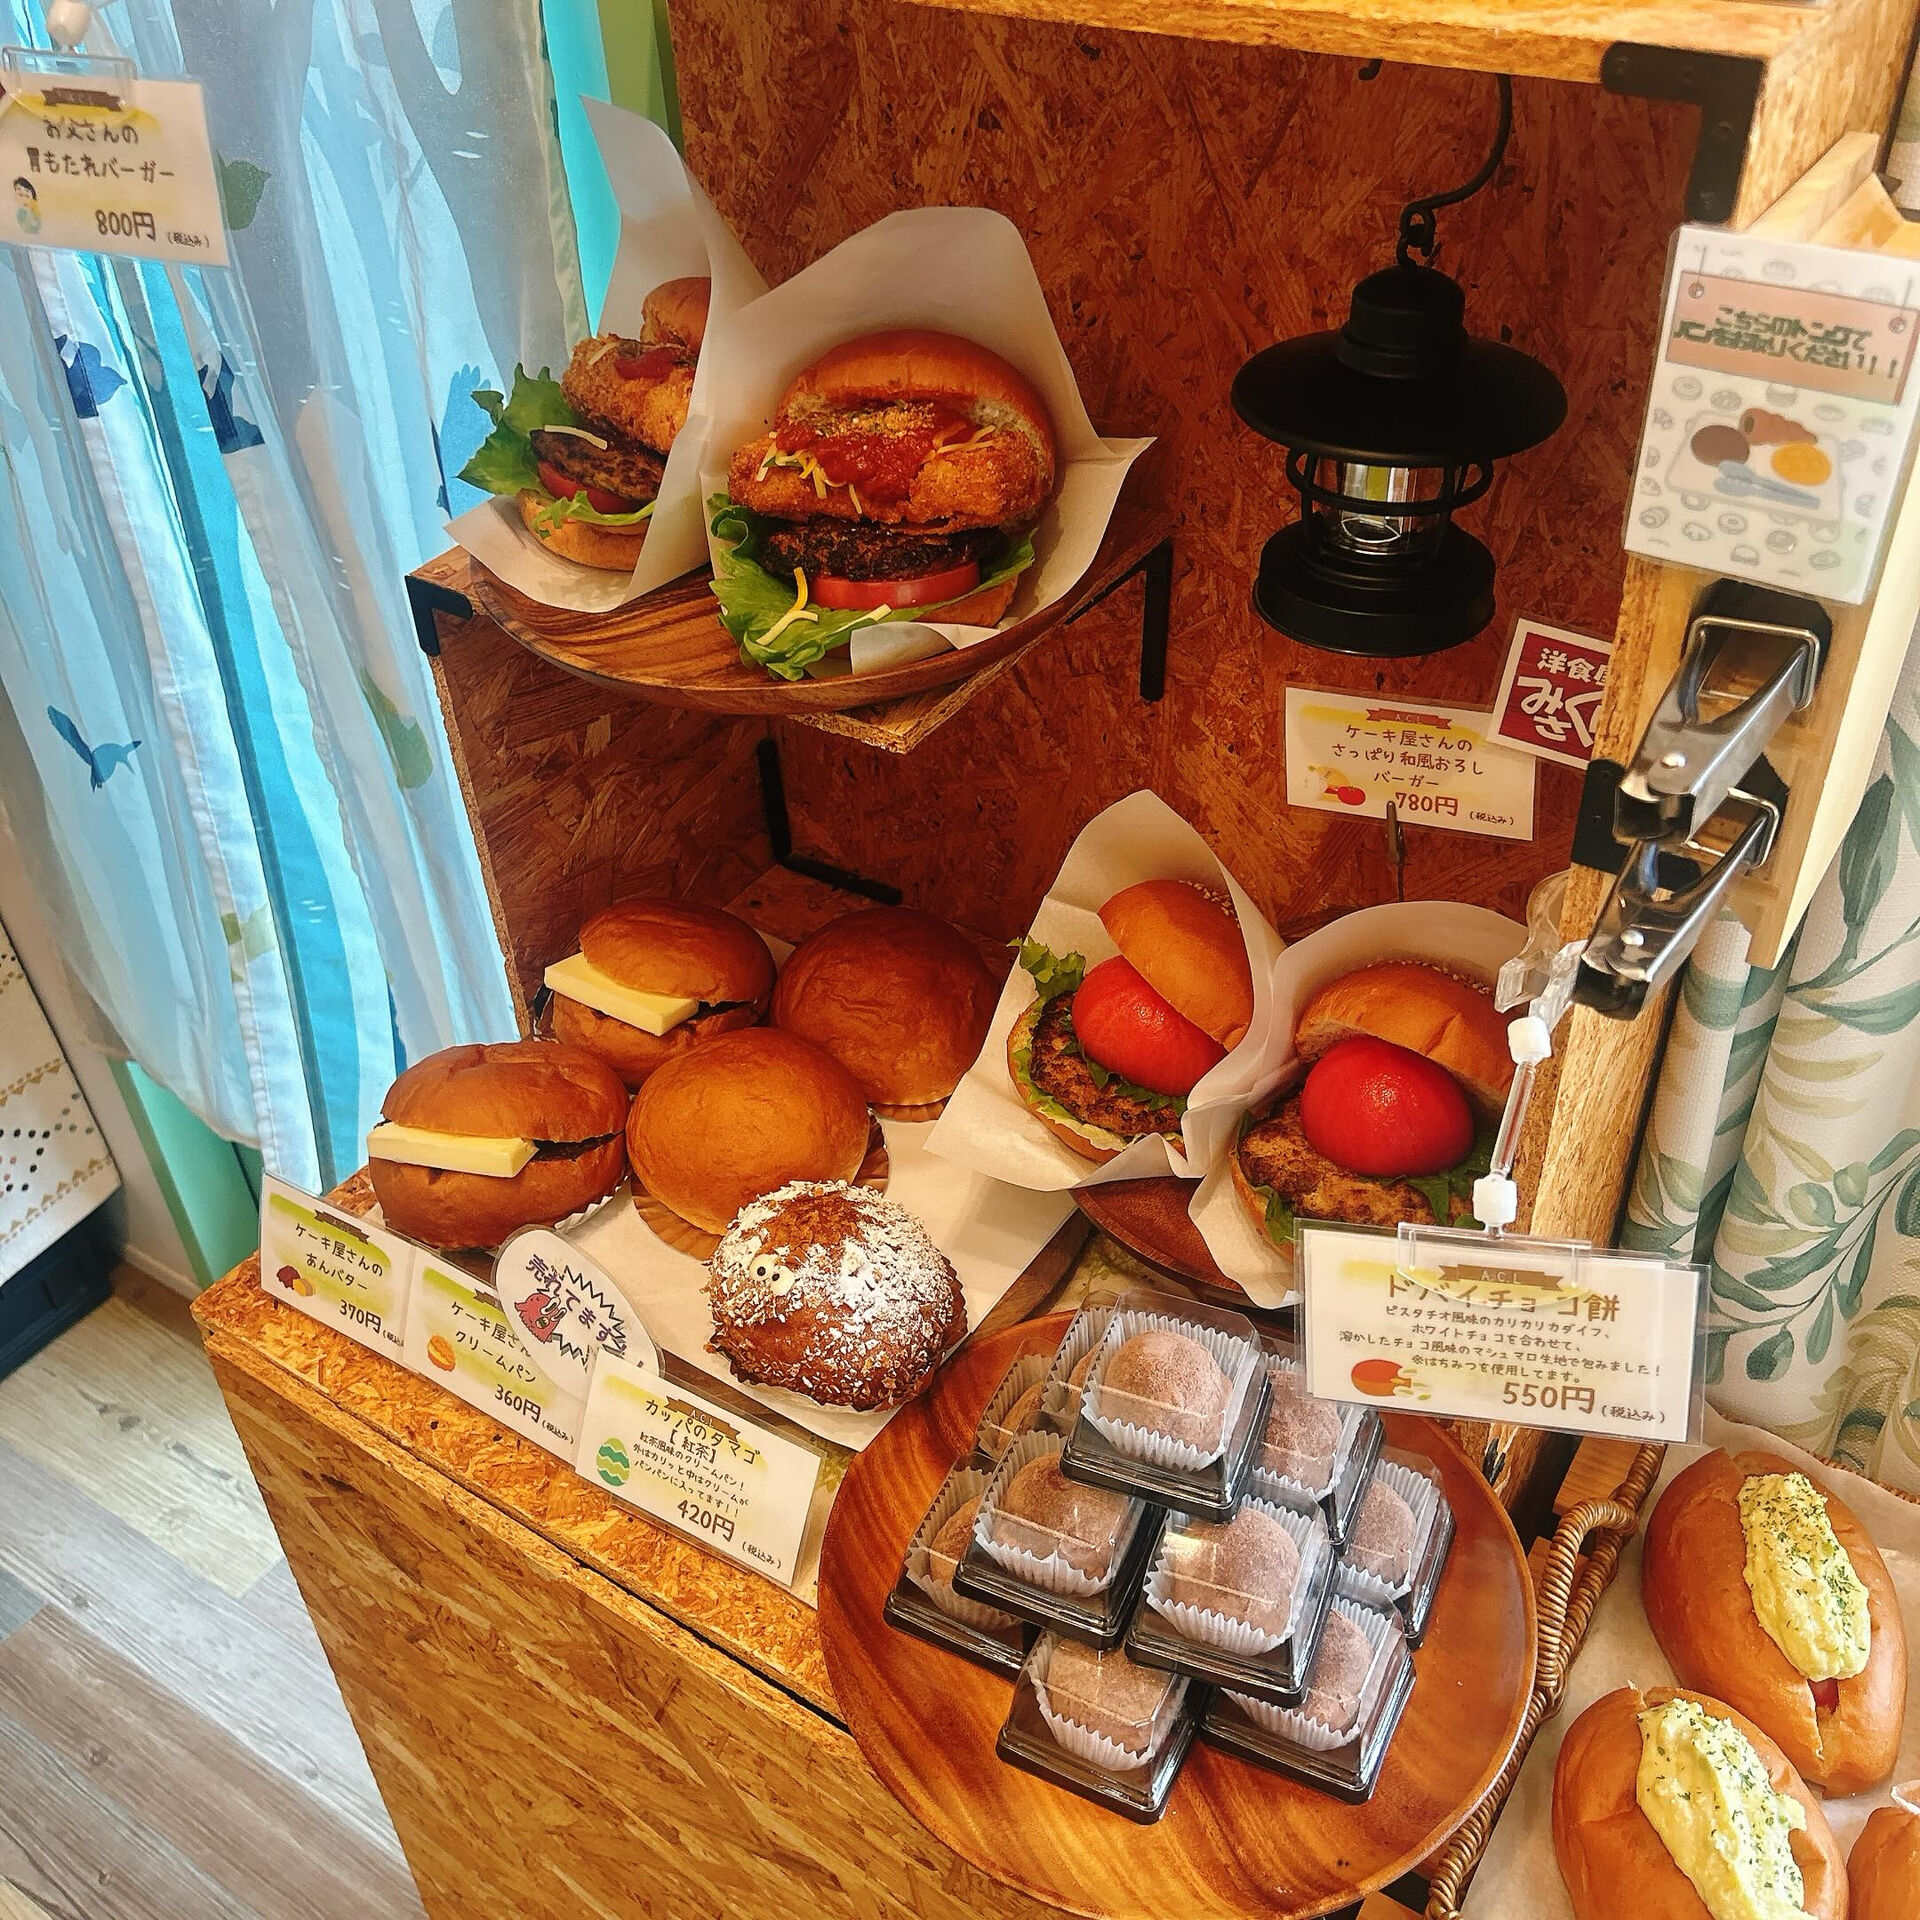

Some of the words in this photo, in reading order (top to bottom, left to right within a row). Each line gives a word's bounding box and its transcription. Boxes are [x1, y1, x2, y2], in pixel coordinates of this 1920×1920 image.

[43, 117, 139, 144] お父さんの
[95, 210, 156, 241] 800円
[1346, 725, 1472, 752] ケーキ屋さんの
[1332, 743, 1484, 776] さっぱり和風おろし
[1374, 771, 1439, 788] バーガー
[1395, 792, 1459, 816] 780円
[295, 1223, 383, 1277] ケーキ屋さんの
[306, 1253, 368, 1290] あんバター
[1389, 1275, 1620, 1322] ドバイチョコ餅
[340, 1299, 381, 1334] 370円
[1386, 1305, 1610, 1339] ピスタチオ風味のカリカリカダイフ、
[1411, 1324, 1581, 1352] ホワイトチョコを合わせて、
[456, 1331, 536, 1383] クリームパン
[494, 1384, 541, 1423] 360円
[1503, 1382, 1596, 1415] 550円
[645, 1399, 761, 1465] カッパのタマゴ
[669, 1430, 717, 1464] 【紅茶】
[633, 1443, 749, 1506] 外はカリッと中はクリームが
[639, 1431, 745, 1492] 紅茶風味のクリームパン！
[677, 1499, 735, 1543] 420円
